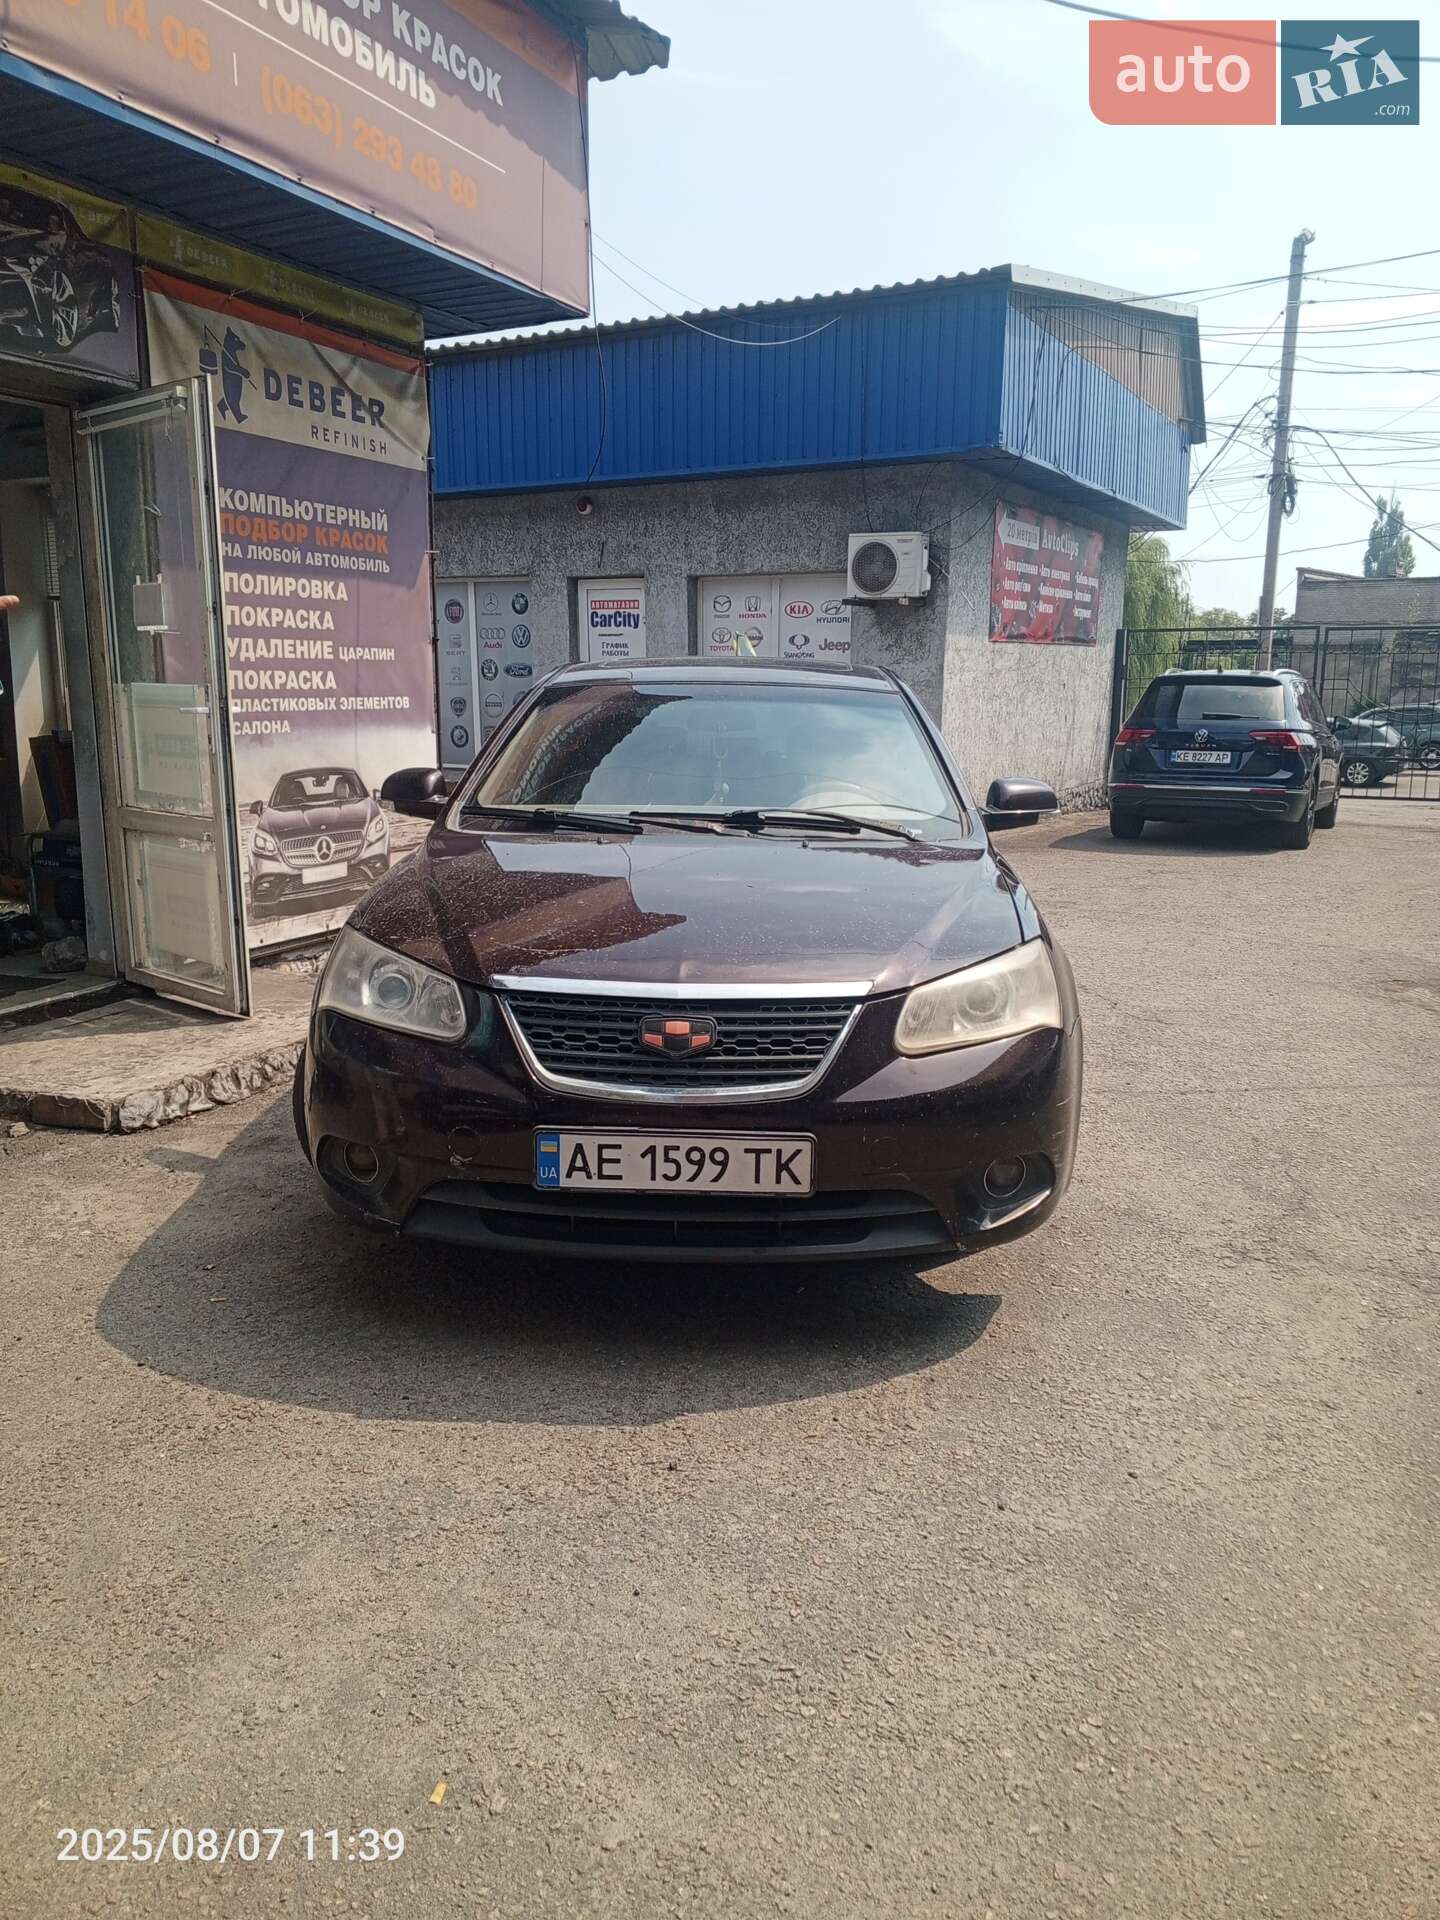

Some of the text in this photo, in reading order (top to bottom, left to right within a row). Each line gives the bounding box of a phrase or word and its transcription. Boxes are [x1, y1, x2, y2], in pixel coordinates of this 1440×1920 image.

[392, 2, 503, 106] КРАСОК
[160, 15, 211, 73] 06
[260, 63, 344, 150] (063)
[352, 116, 405, 172] 293
[411, 151, 443, 193] 48
[449, 168, 478, 209] 80
[263, 367, 385, 428] DEBEER
[311, 425, 388, 455] REFINISH
[219, 487, 389, 532] КОМПЬЮТЕРНЫЙ
[220, 512, 389, 554] ПОДБОР КРАСОК
[1041, 529, 1079, 561] AvtoClips
[222, 542, 391, 574] НА ЛЮБОЙ АВТОМОБИЛЬ
[224, 571, 349, 601] ПОЛИРОВКА
[226, 605, 335, 630] ПОКРАСКА
[591, 611, 640, 629] CarCity
[789, 604, 809, 615] KIA
[816, 616, 850, 624] HYUNDAI
[227, 637, 395, 662] УДАЛЕНИЕ ЦАРАПИН
[483, 641, 503, 649] Audi
[818, 638, 850, 653] Jeep
[230, 670, 337, 690] ПОКРАСКА
[340, 696, 410, 710] ЭЛЕМЕНТОВ
[233, 720, 291, 736] САЛОНА
[1176, 752, 1229, 762] KE 8227 AP
[540, 1167, 558, 1179] UA
[565, 1143, 803, 1185] AE 1599 TK
